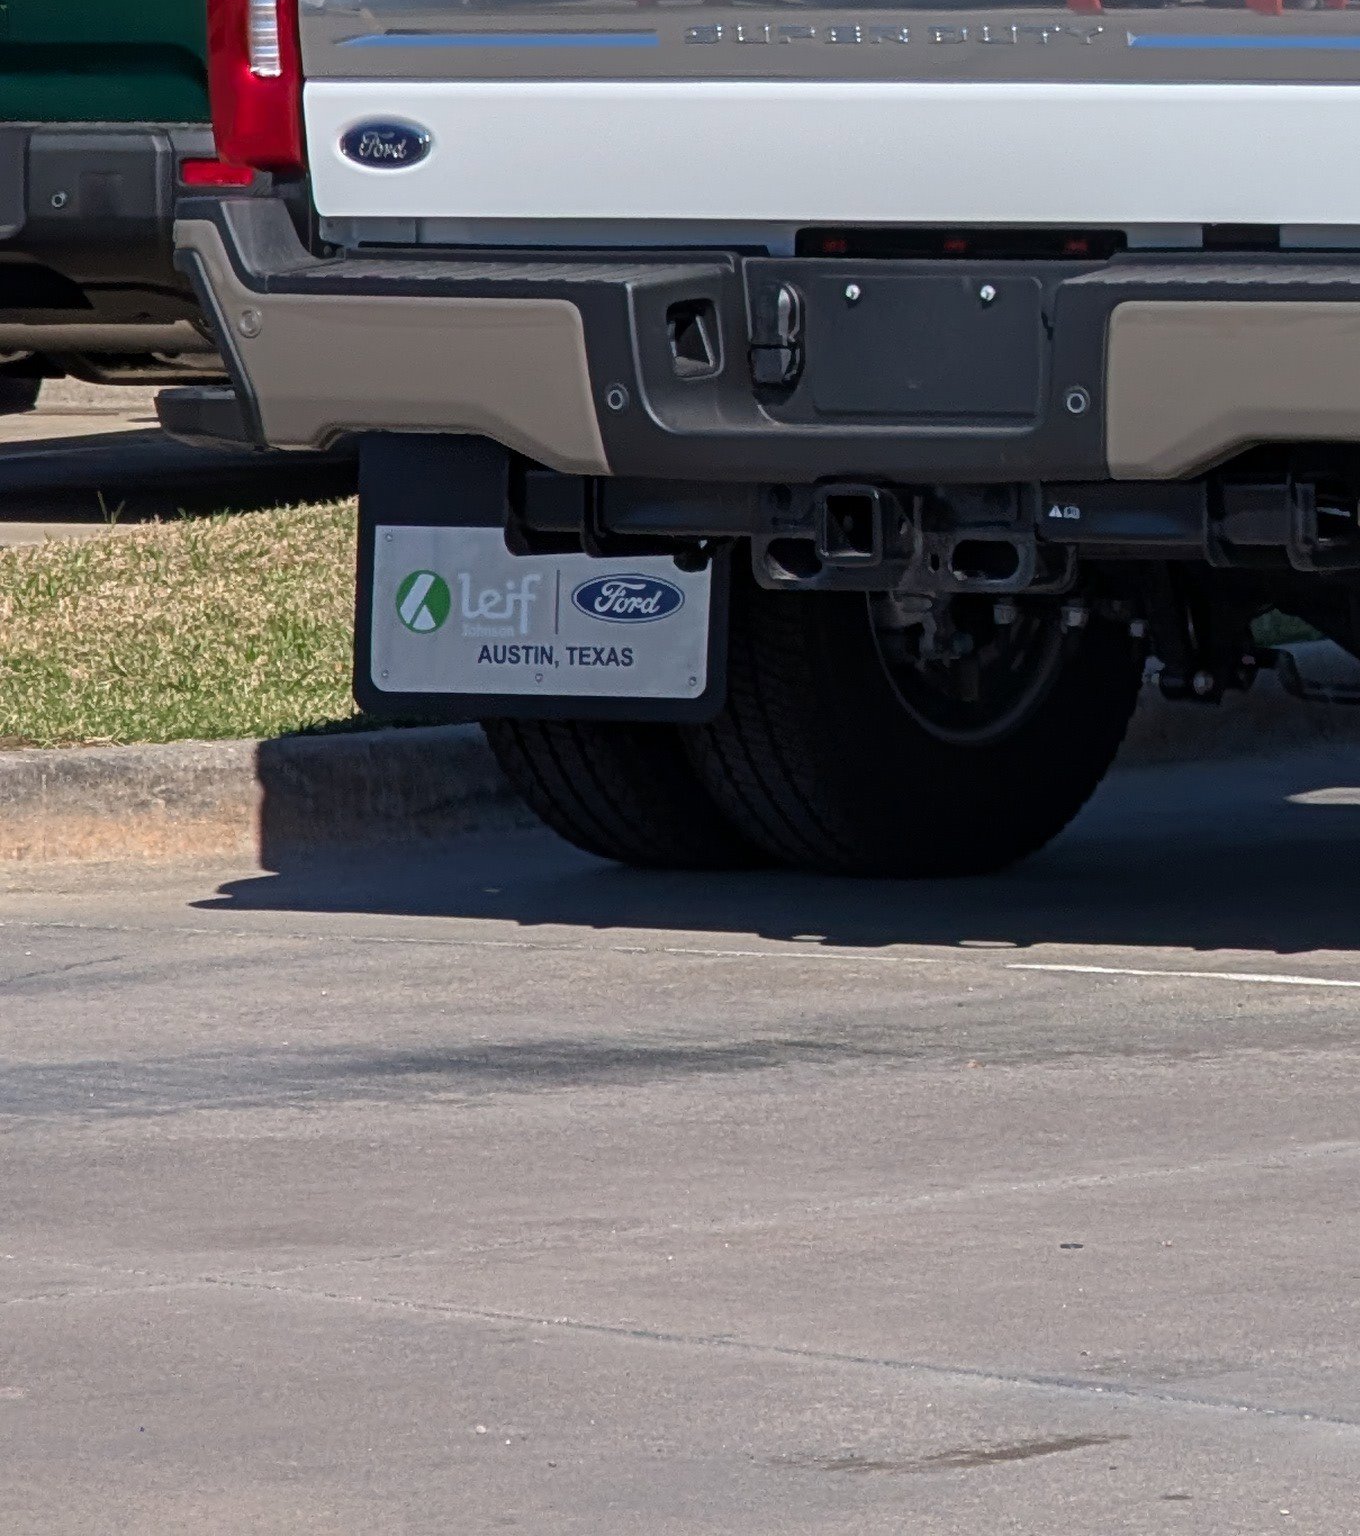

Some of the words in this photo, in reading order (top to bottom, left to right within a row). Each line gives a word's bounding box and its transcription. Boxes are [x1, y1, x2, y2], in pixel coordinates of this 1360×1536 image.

[595, 580, 663, 615] Ford
[478, 645, 560, 668] AUSTIN,
[566, 646, 634, 667] TEXAS
